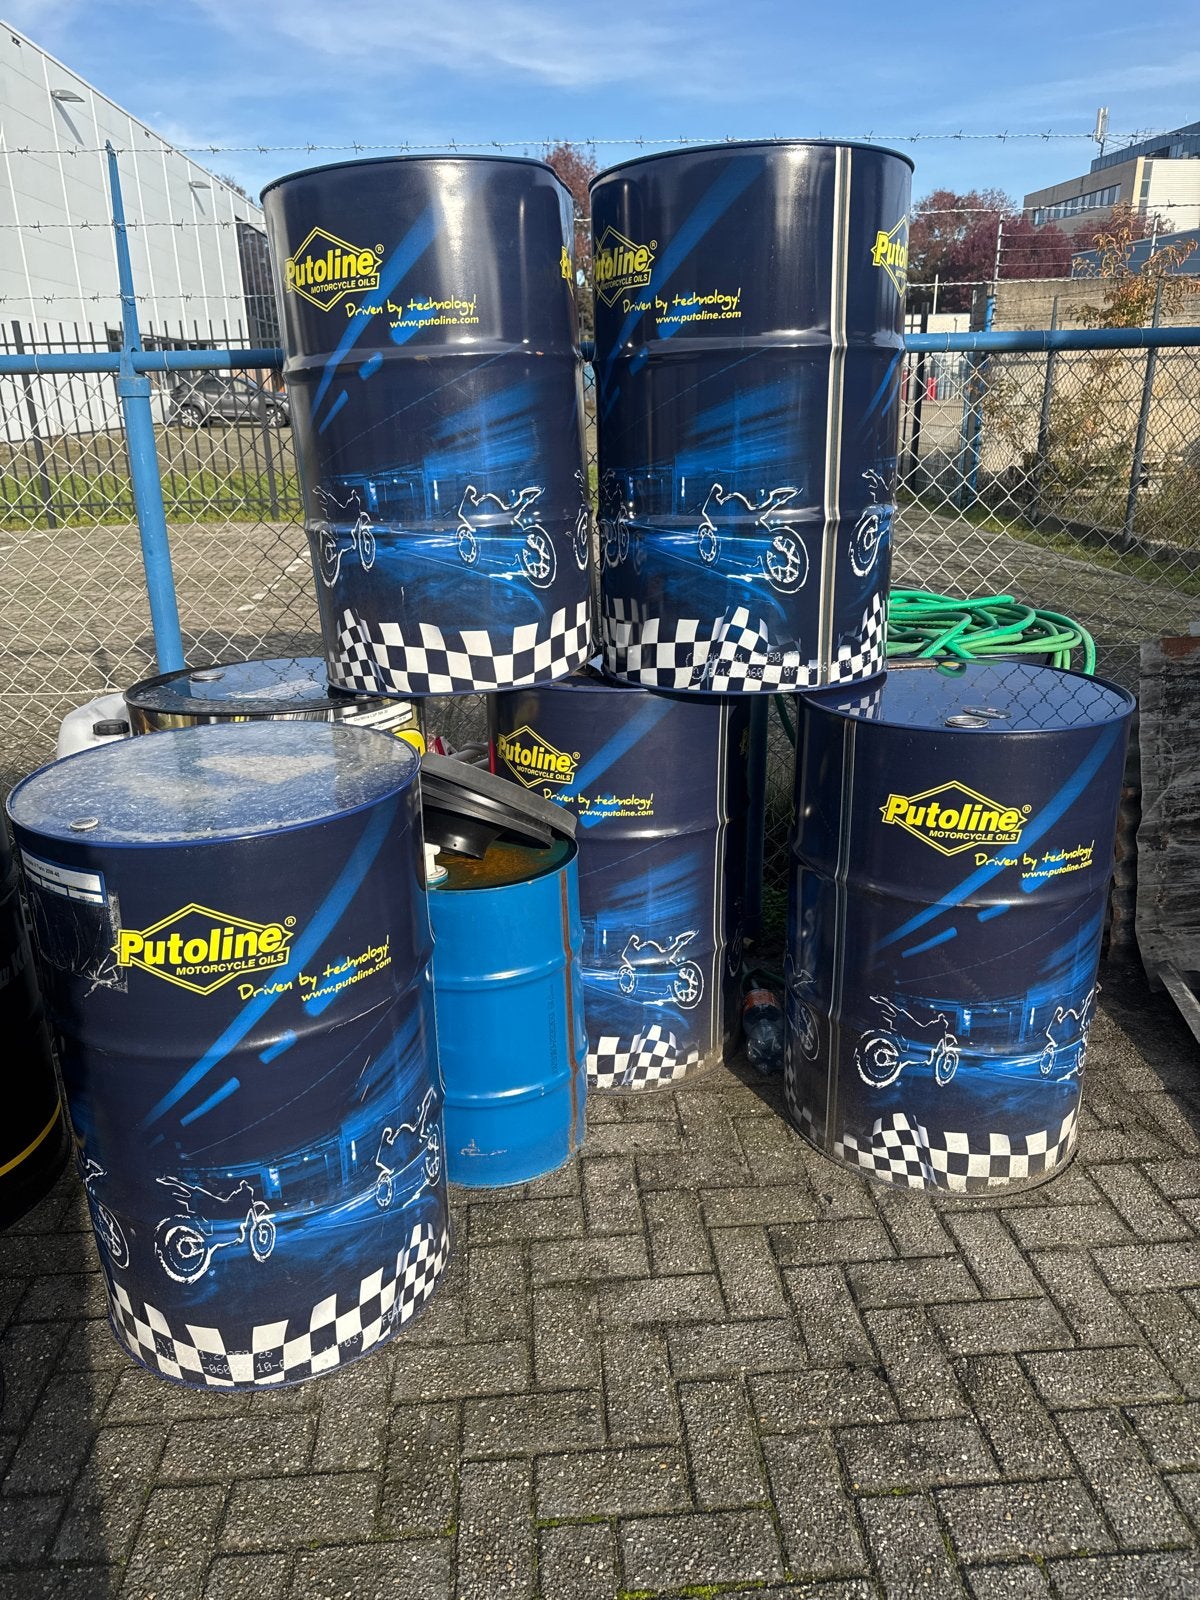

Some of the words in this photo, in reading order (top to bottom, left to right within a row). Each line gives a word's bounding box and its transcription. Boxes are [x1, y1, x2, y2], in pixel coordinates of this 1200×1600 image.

[285, 249, 374, 290] Putoline
[634, 273, 648, 283] OILS
[310, 281, 356, 294] MOTORCYCLE
[358, 277, 376, 287] OILS
[345, 302, 383, 317] Driven
[387, 299, 403, 319] by
[407, 294, 477, 316] technology!
[622, 299, 652, 314] Driven
[655, 295, 668, 315] by
[672, 287, 741, 310] technology!
[390, 316, 479, 329] www.putoline.com
[655, 310, 742, 324] www.putoline.com
[498, 735, 571, 773] Putoline
[516, 765, 554, 778] MOTORCYCLE
[555, 773, 571, 781] OILS
[543, 788, 574, 803] Driven
[577, 793, 590, 809] by
[594, 792, 654, 810] technology!
[578, 809, 654, 818] www.putoline.com
[886, 797, 1019, 832] Putoline
[929, 830, 993, 841] MOTORCYCLE
[995, 833, 1017, 841] OILS
[974, 853, 1018, 866] Driven
[1022, 853, 1037, 871] by
[1021, 860, 1093, 878] www.putoline.com
[120, 926, 283, 965] Putoline
[176, 959, 256, 976] MOTORCYCLE
[258, 952, 284, 966] OILS
[238, 981, 293, 1001] Driven
[298, 972, 318, 990] by
[322, 934, 390, 977] technology!
[301, 956, 392, 1002] www.putoline.com
